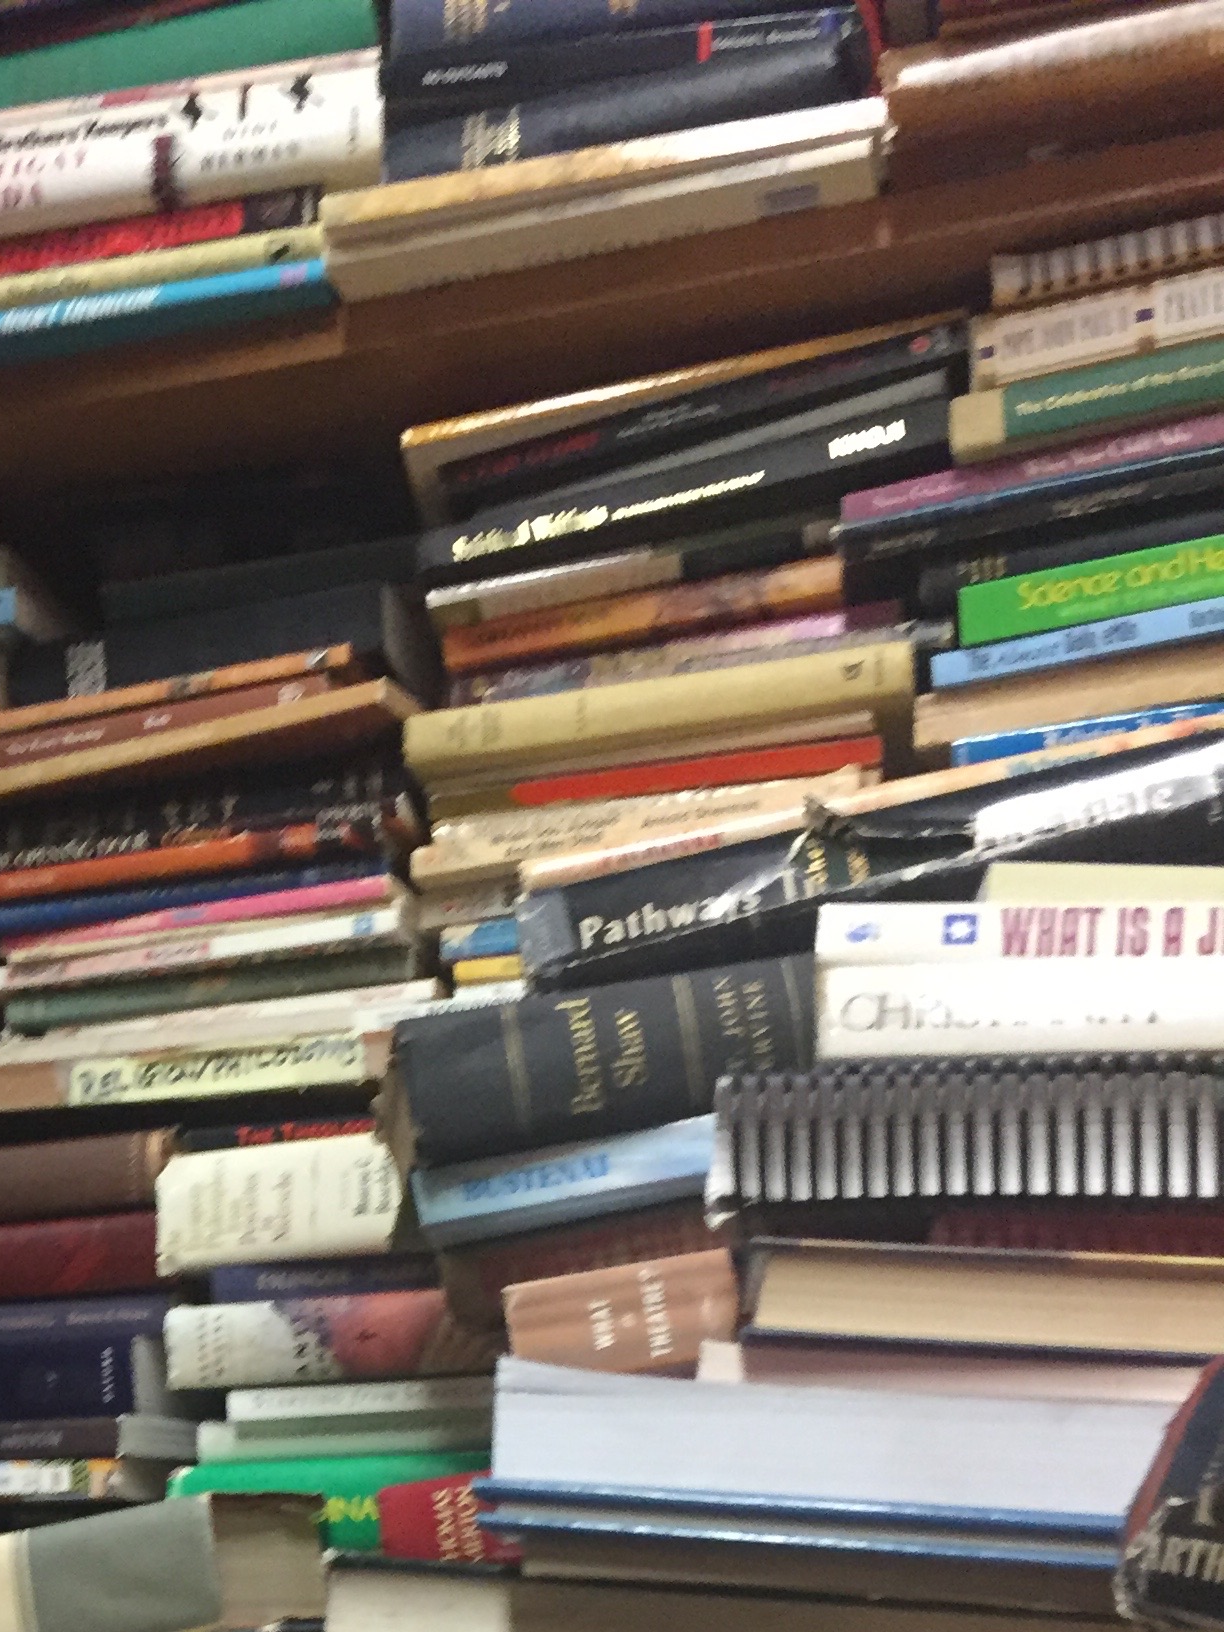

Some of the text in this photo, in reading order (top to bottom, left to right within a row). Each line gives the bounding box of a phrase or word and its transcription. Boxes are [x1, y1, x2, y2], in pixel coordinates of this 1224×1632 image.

[1019, 571, 1118, 611] Science
[578, 890, 763, 952] Pathways
[999, 906, 1104, 958] WHAT
[1115, 906, 1151, 958] IS
[1162, 905, 1186, 958] A
[587, 1298, 617, 1351] WHAT
